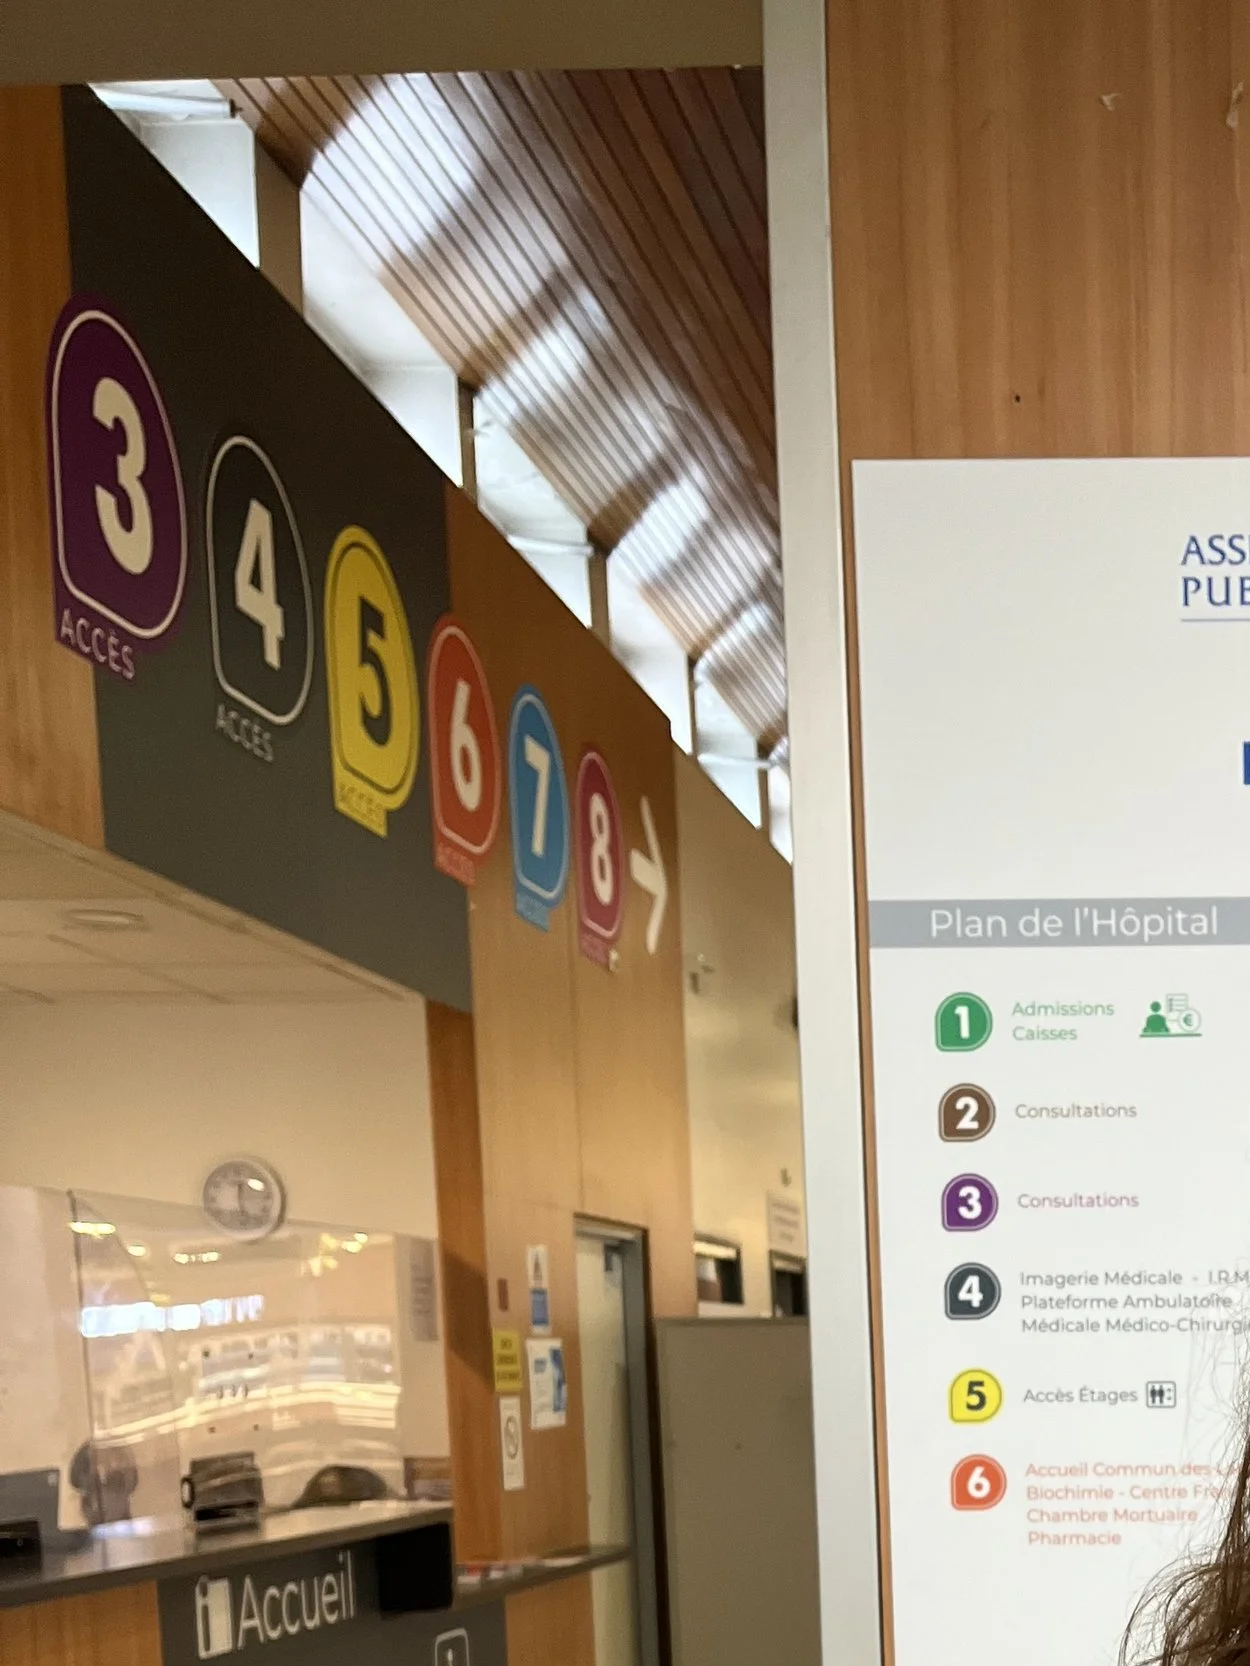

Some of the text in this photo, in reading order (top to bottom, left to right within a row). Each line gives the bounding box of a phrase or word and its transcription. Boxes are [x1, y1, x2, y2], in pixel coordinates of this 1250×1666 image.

[93, 377, 153, 574] 3
[235, 500, 285, 670] 4
[60, 608, 135, 680] ACCÈS
[357, 595, 393, 746] 5
[450, 681, 480, 811] 6
[523, 737, 551, 856] 7
[590, 793, 613, 905] 8
[930, 904, 1218, 943] Plan de l'Hôpital
[954, 1006, 971, 1039] 1
[1011, 1000, 1115, 1018] Admissions
[1011, 1025, 1078, 1042] Caisses
[955, 1097, 979, 1129] 2
[1014, 1102, 1137, 1119] Consultations
[958, 1186, 982, 1219] 3
[1017, 1191, 1140, 1209] Consultations
[958, 1275, 984, 1307] 4
[1019, 1271, 1100, 1289] Imagerie
[1104, 1270, 1183, 1286] Médicale
[1021, 1292, 1233, 1310] Plateforme Ambulatoire
[1021, 1317, 1101, 1333] Médicale
[966, 1381, 987, 1411] 5
[1023, 1385, 1139, 1406] Accès Étages
[967, 1466, 991, 1498] 6
[1024, 1462, 1089, 1478] Accueil
[1092, 1461, 1177, 1477] Commun
[1181, 1461, 1211, 1476] des
[1026, 1485, 1114, 1501] Biochimie
[1129, 1484, 1189, 1500] Centre
[1026, 1507, 1199, 1524] Chambre Mortuaire
[1028, 1530, 1122, 1546] Pharmacie
[237, 1550, 354, 1650] Accueil
